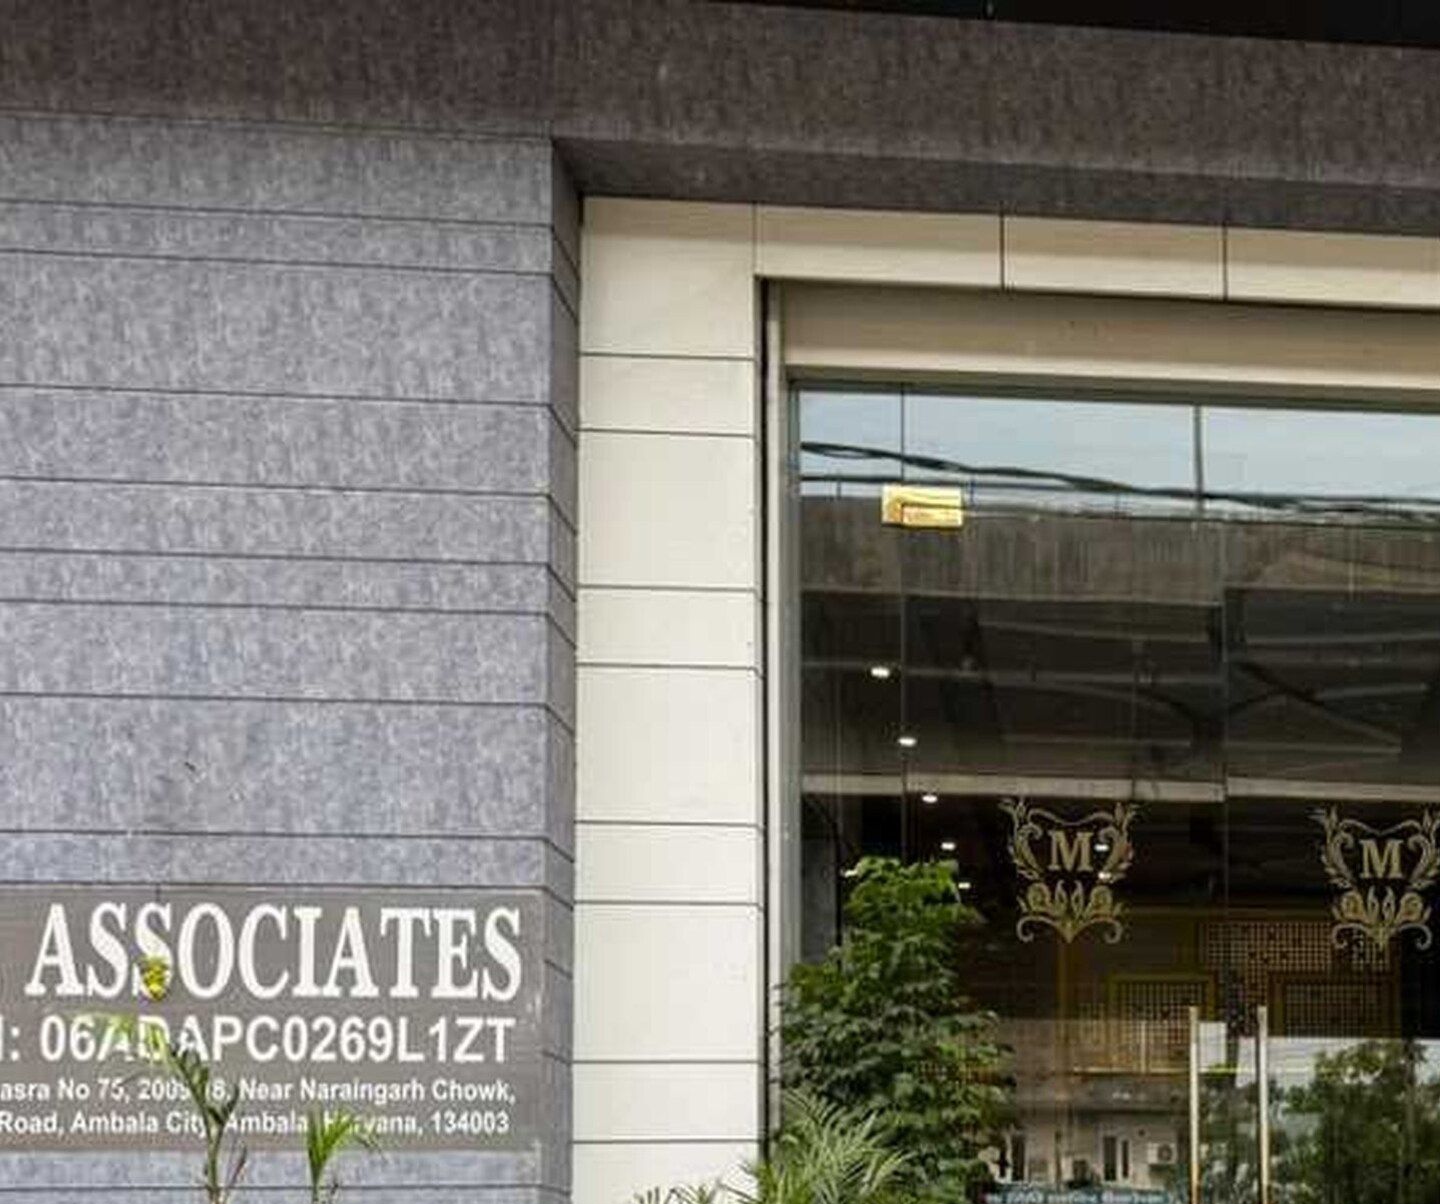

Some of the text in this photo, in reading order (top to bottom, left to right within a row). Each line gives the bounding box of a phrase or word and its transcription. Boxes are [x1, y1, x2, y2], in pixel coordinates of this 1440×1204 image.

[1048, 830, 1093, 872] M
[1359, 838, 1404, 880] M
[25, 900, 523, 1002] ASSOCIATES
[58, 1076, 91, 1101] No
[97, 1077, 130, 1104] 75,
[240, 1077, 293, 1101] Near
[300, 1076, 426, 1105] Naraingarh
[432, 1077, 516, 1105] Chowk,
[0, 1109, 64, 1136] Road,
[70, 1110, 159, 1134] Ambala
[431, 1110, 510, 1134] 134003
